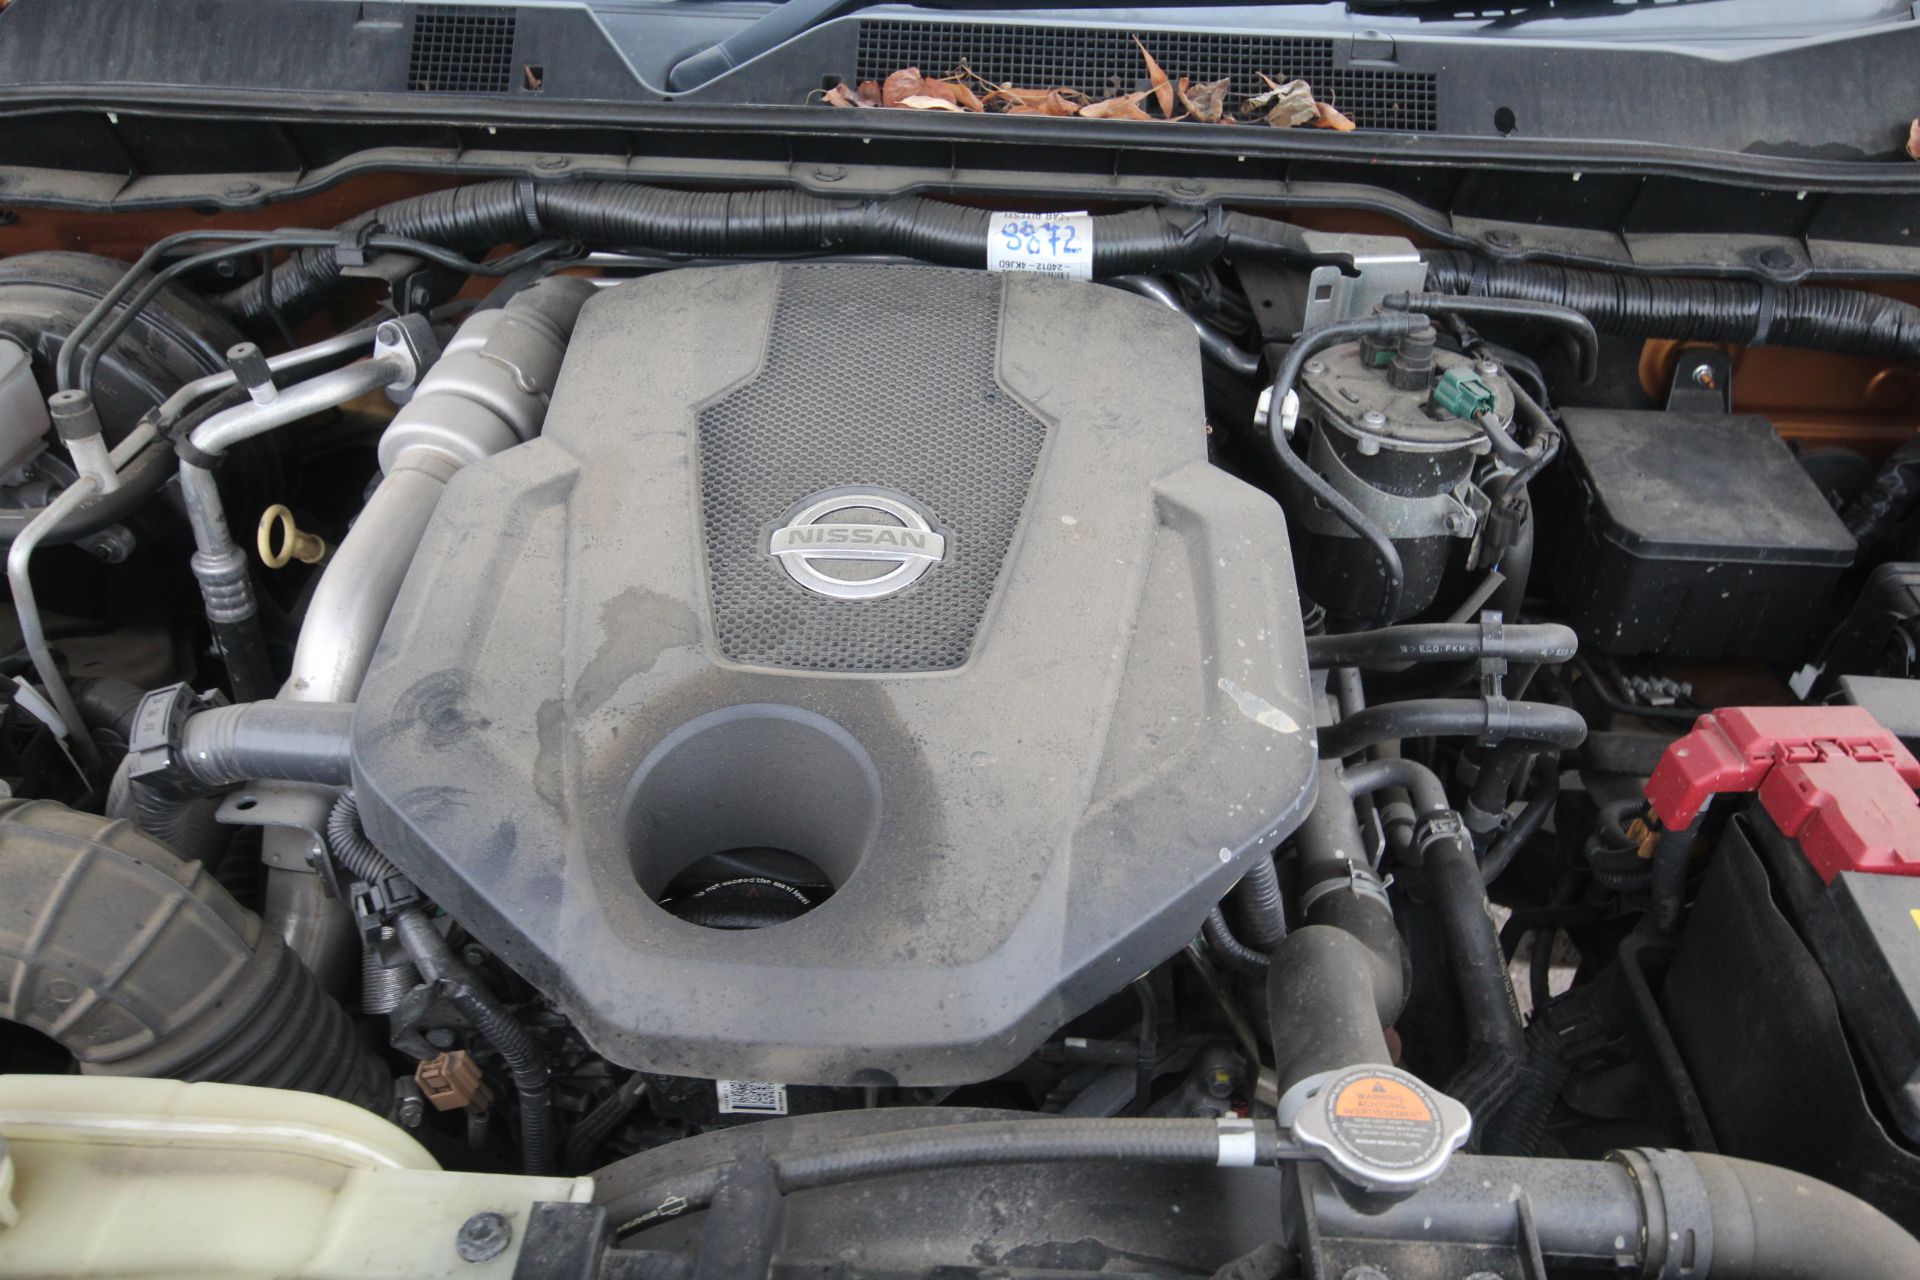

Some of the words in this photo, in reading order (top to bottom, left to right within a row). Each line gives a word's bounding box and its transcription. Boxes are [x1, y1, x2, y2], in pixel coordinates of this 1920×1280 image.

[788, 528, 926, 549] NISSAN
[706, 883, 721, 893] not
[721, 877, 755, 887] exceed
[756, 877, 771, 885] the
[792, 889, 811, 905] level
